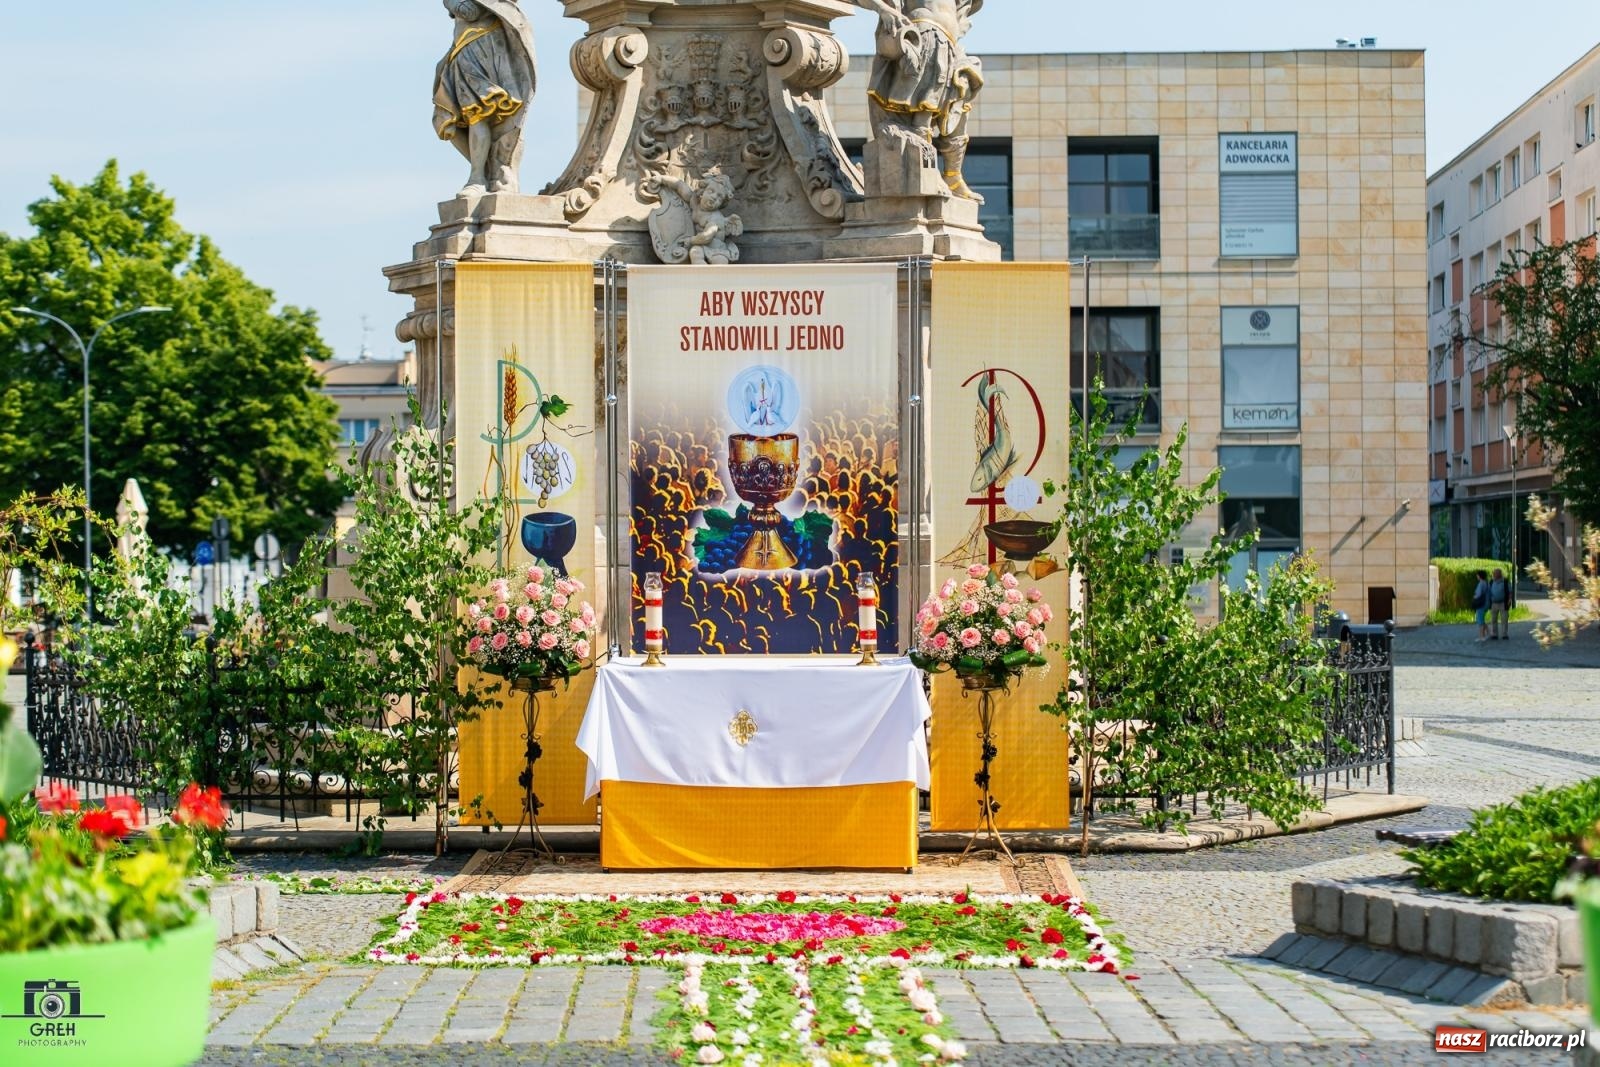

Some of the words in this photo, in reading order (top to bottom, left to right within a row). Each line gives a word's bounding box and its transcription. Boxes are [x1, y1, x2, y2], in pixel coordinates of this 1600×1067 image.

[1226, 140, 1288, 151] KANCELARIA
[1225, 154, 1290, 164] ADWOKACKA
[700, 291, 735, 316] ABY
[741, 290, 825, 316] WSZYSCY
[680, 326, 779, 351] STANOWILI
[786, 325, 844, 350] JEDNO
